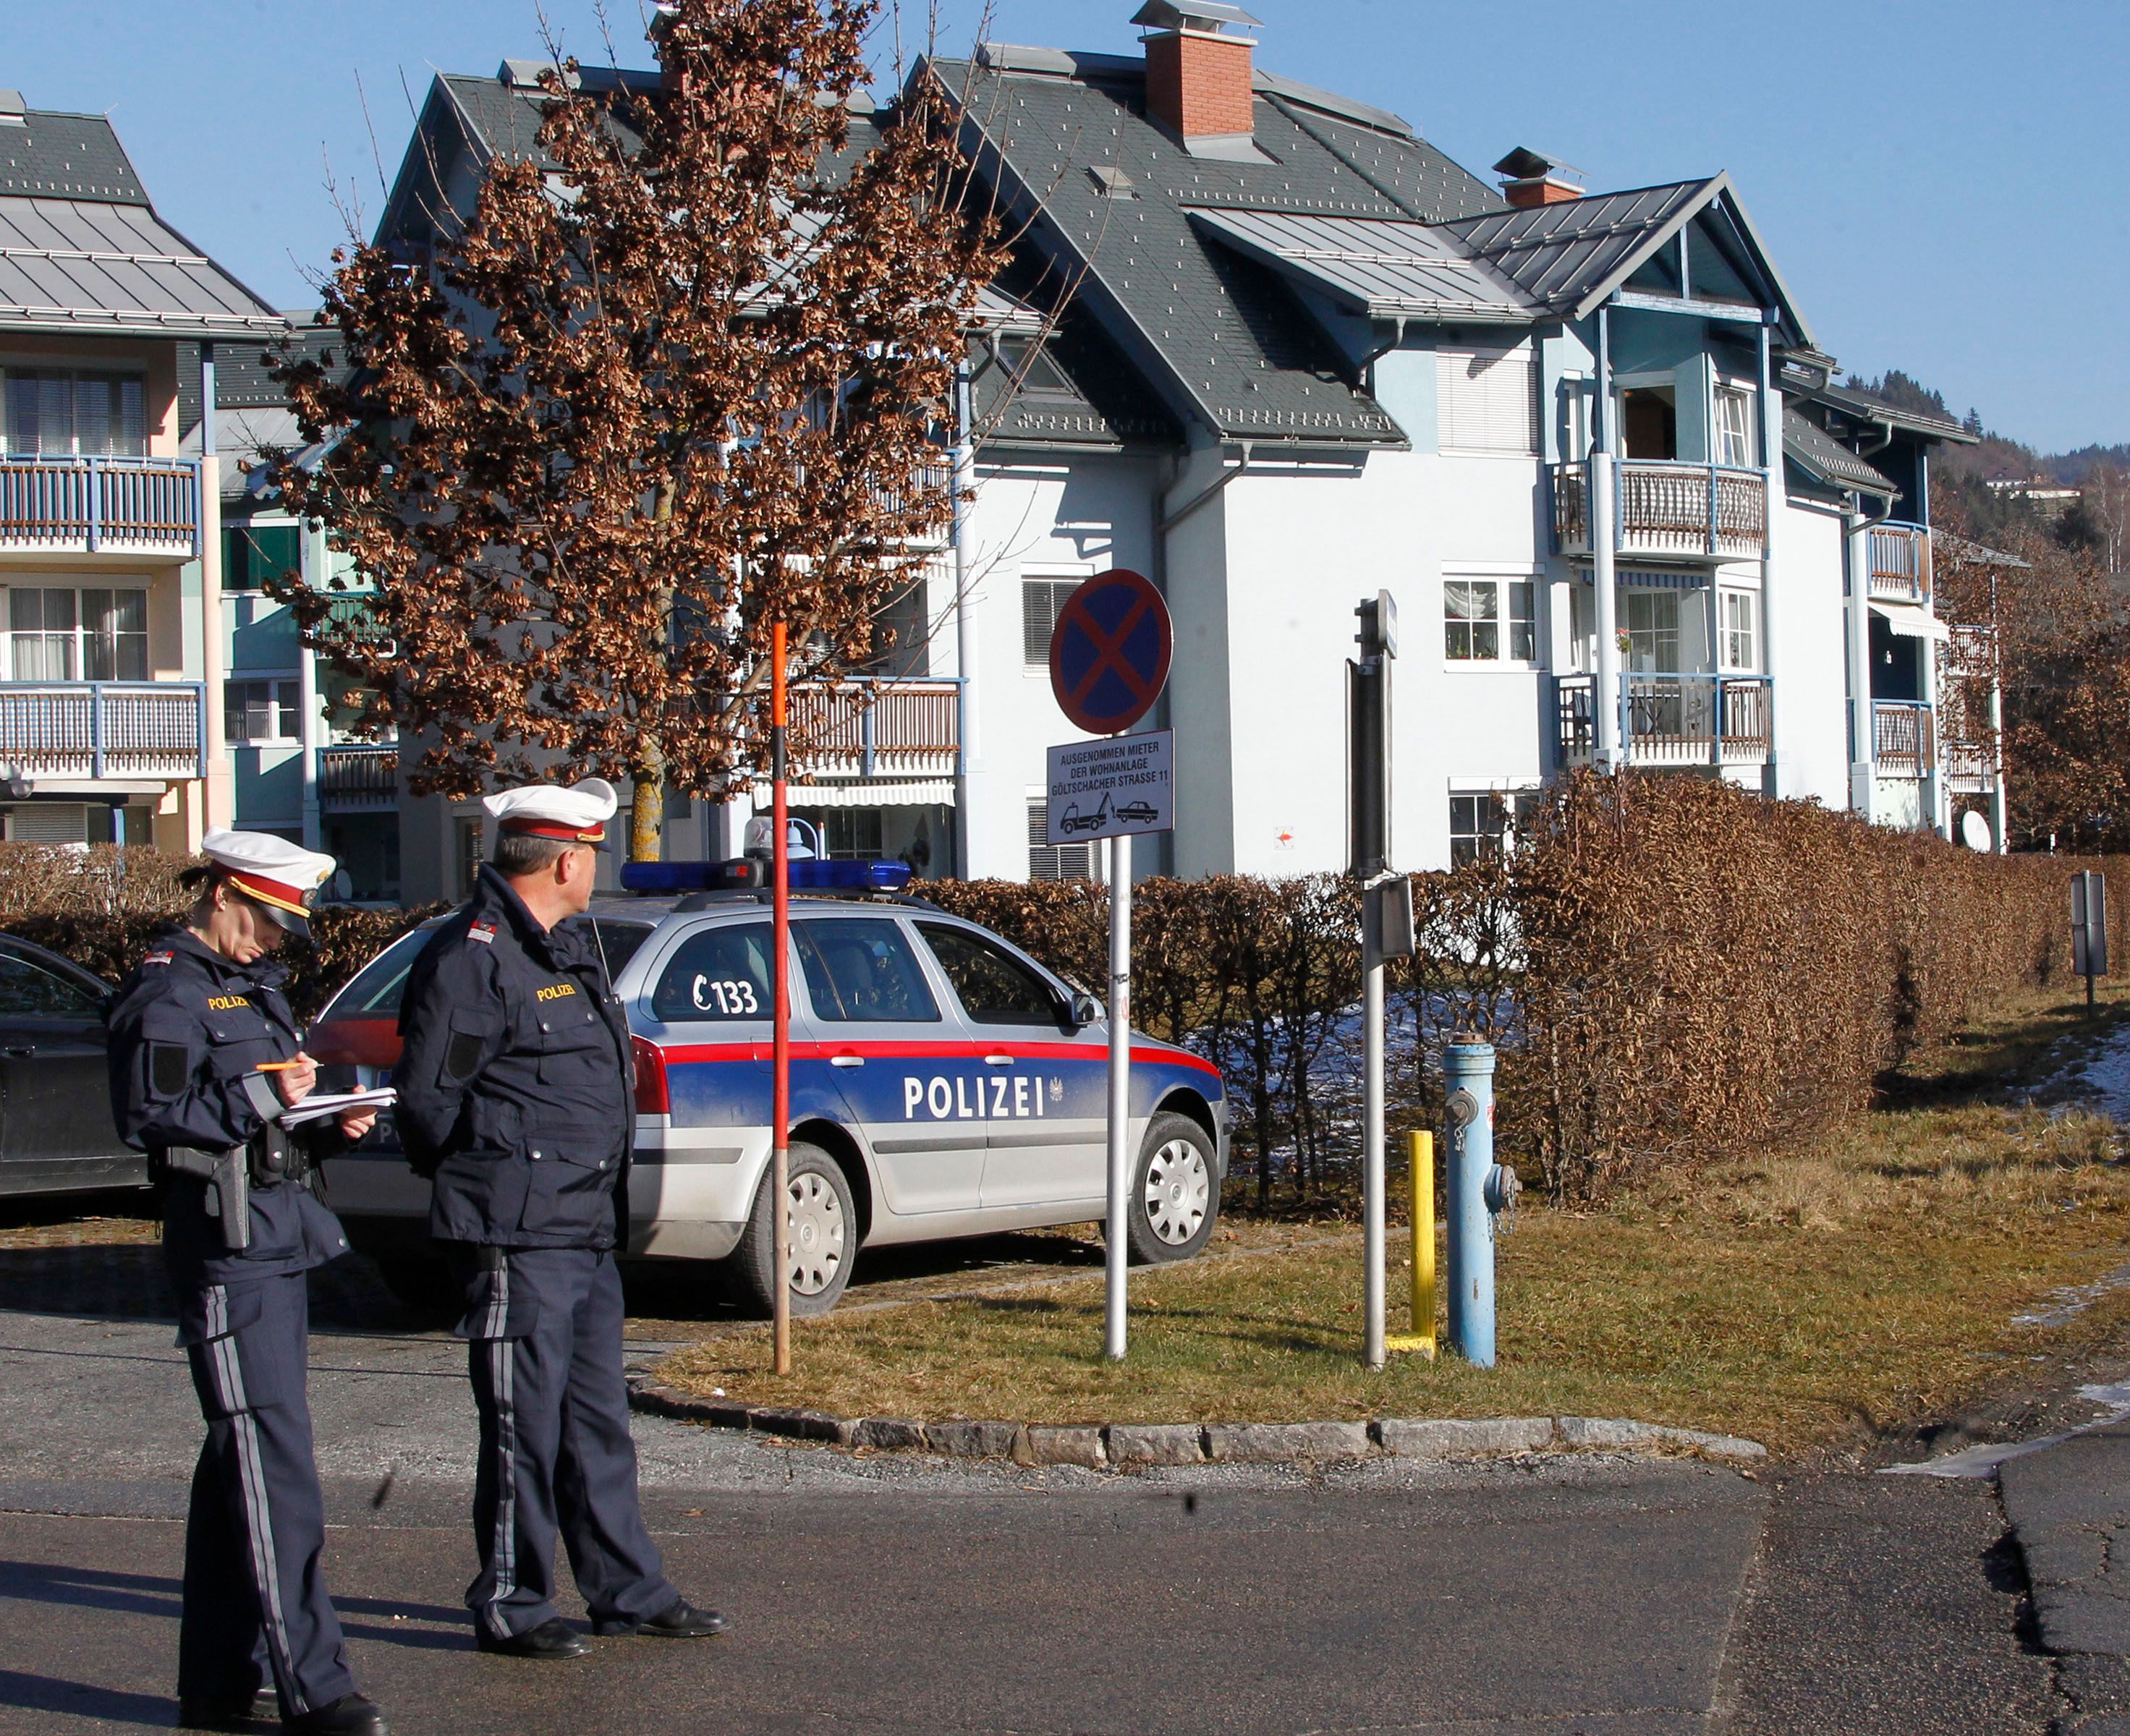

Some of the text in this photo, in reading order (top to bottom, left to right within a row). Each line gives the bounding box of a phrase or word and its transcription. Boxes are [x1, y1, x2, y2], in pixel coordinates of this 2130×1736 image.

[1061, 741, 1159, 766] AUSGENOMMEN MIETER
[1070, 757, 1148, 779] DER WOHNANLAGE
[1051, 770, 1168, 796] GÖLTSCHACHER STRASSE 11
[710, 980, 758, 1014] 133
[904, 1076, 1044, 1119] POLIZEI
